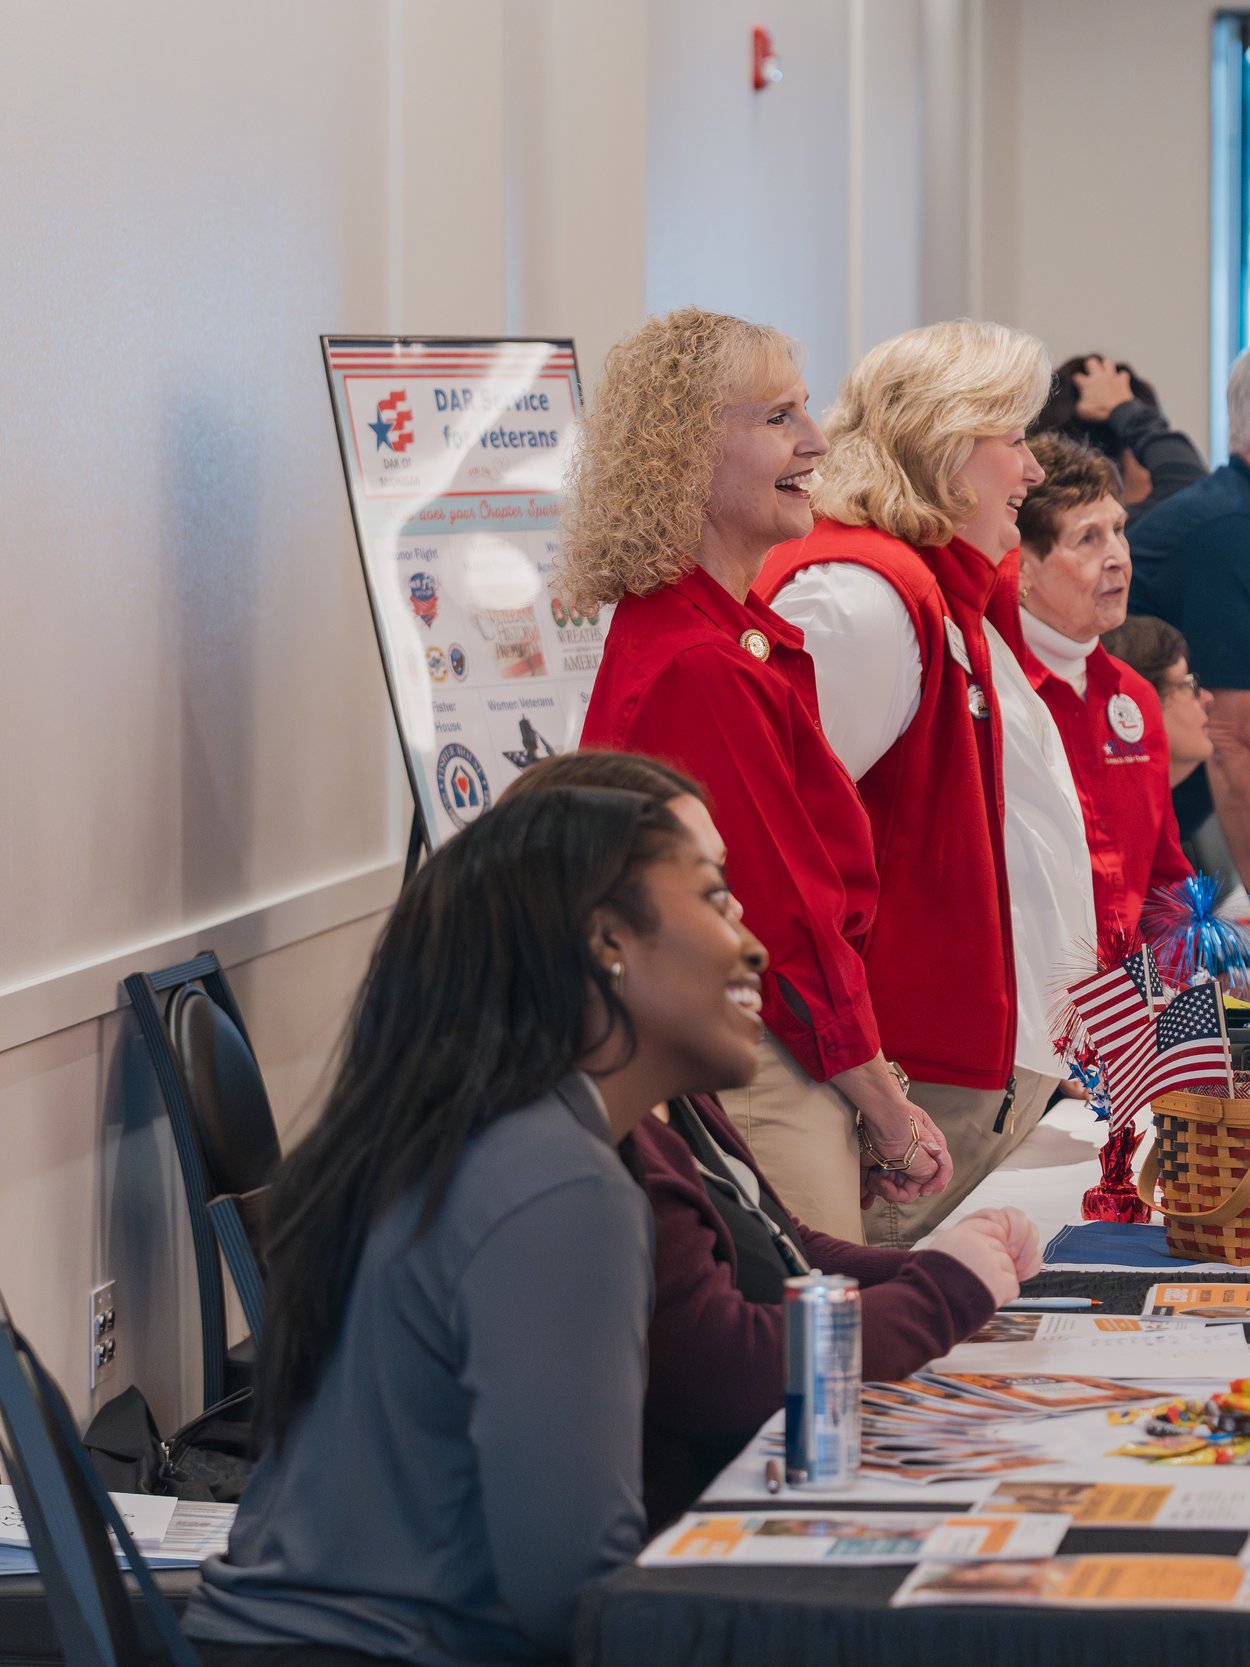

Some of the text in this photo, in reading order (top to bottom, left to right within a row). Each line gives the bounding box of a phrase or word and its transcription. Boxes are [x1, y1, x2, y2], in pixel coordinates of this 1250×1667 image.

[434, 387, 551, 412] DAR Sevice
[480, 426, 560, 449] Veterans
[480, 499, 524, 521] Chapter
[390, 547, 440, 563] onor Flight
[432, 700, 457, 713] Fisher
[488, 697, 555, 711] Women Veterans
[435, 719, 463, 732] House
